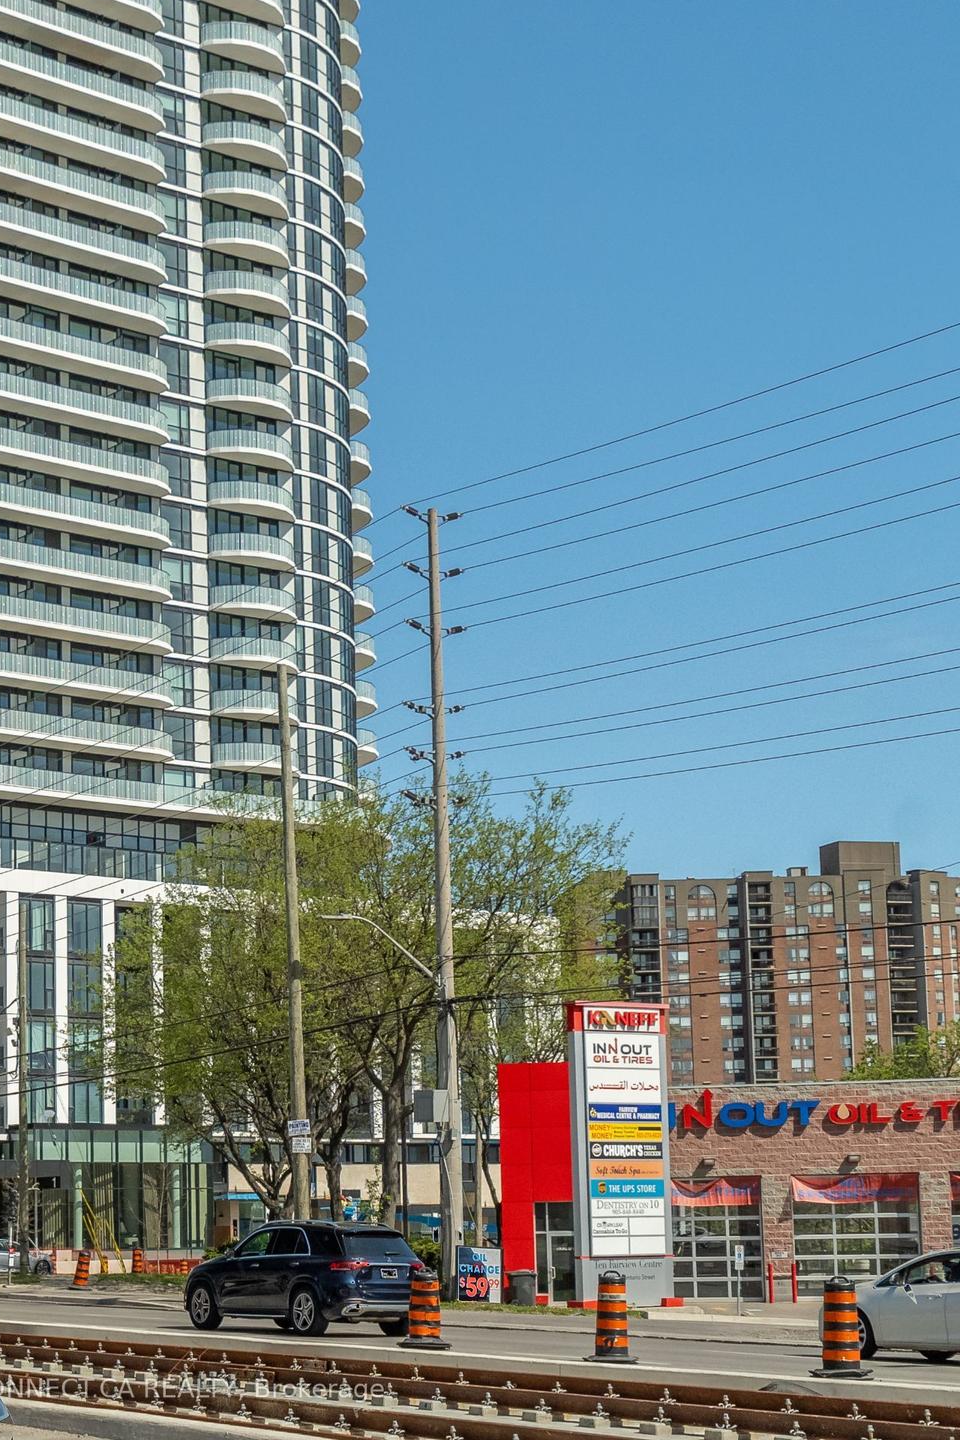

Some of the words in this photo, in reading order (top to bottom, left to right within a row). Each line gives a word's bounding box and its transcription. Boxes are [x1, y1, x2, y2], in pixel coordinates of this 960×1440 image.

[589, 1010, 658, 1027] KANEFF
[620, 1044, 652, 1055] OUT
[593, 1055, 610, 1063] OIL
[622, 1056, 653, 1064] TIRES
[719, 1100, 821, 1128] OUT
[828, 1102, 892, 1125] OIL
[900, 1101, 925, 1123] &
[603, 1144, 644, 1157] CHURCH'S
[595, 1165, 608, 1176] Soft
[629, 1166, 641, 1176] Spa
[608, 1184, 621, 1193] THE
[622, 1184, 635, 1193] UPS
[637, 1184, 656, 1193] STORE
[650, 1199, 660, 1209] 10
[472, 1252, 488, 1262] OIL
[459, 1263, 500, 1274] CHANGE
[608, 1259, 637, 1269] Fairview
[639, 1260, 663, 1268] Centre
